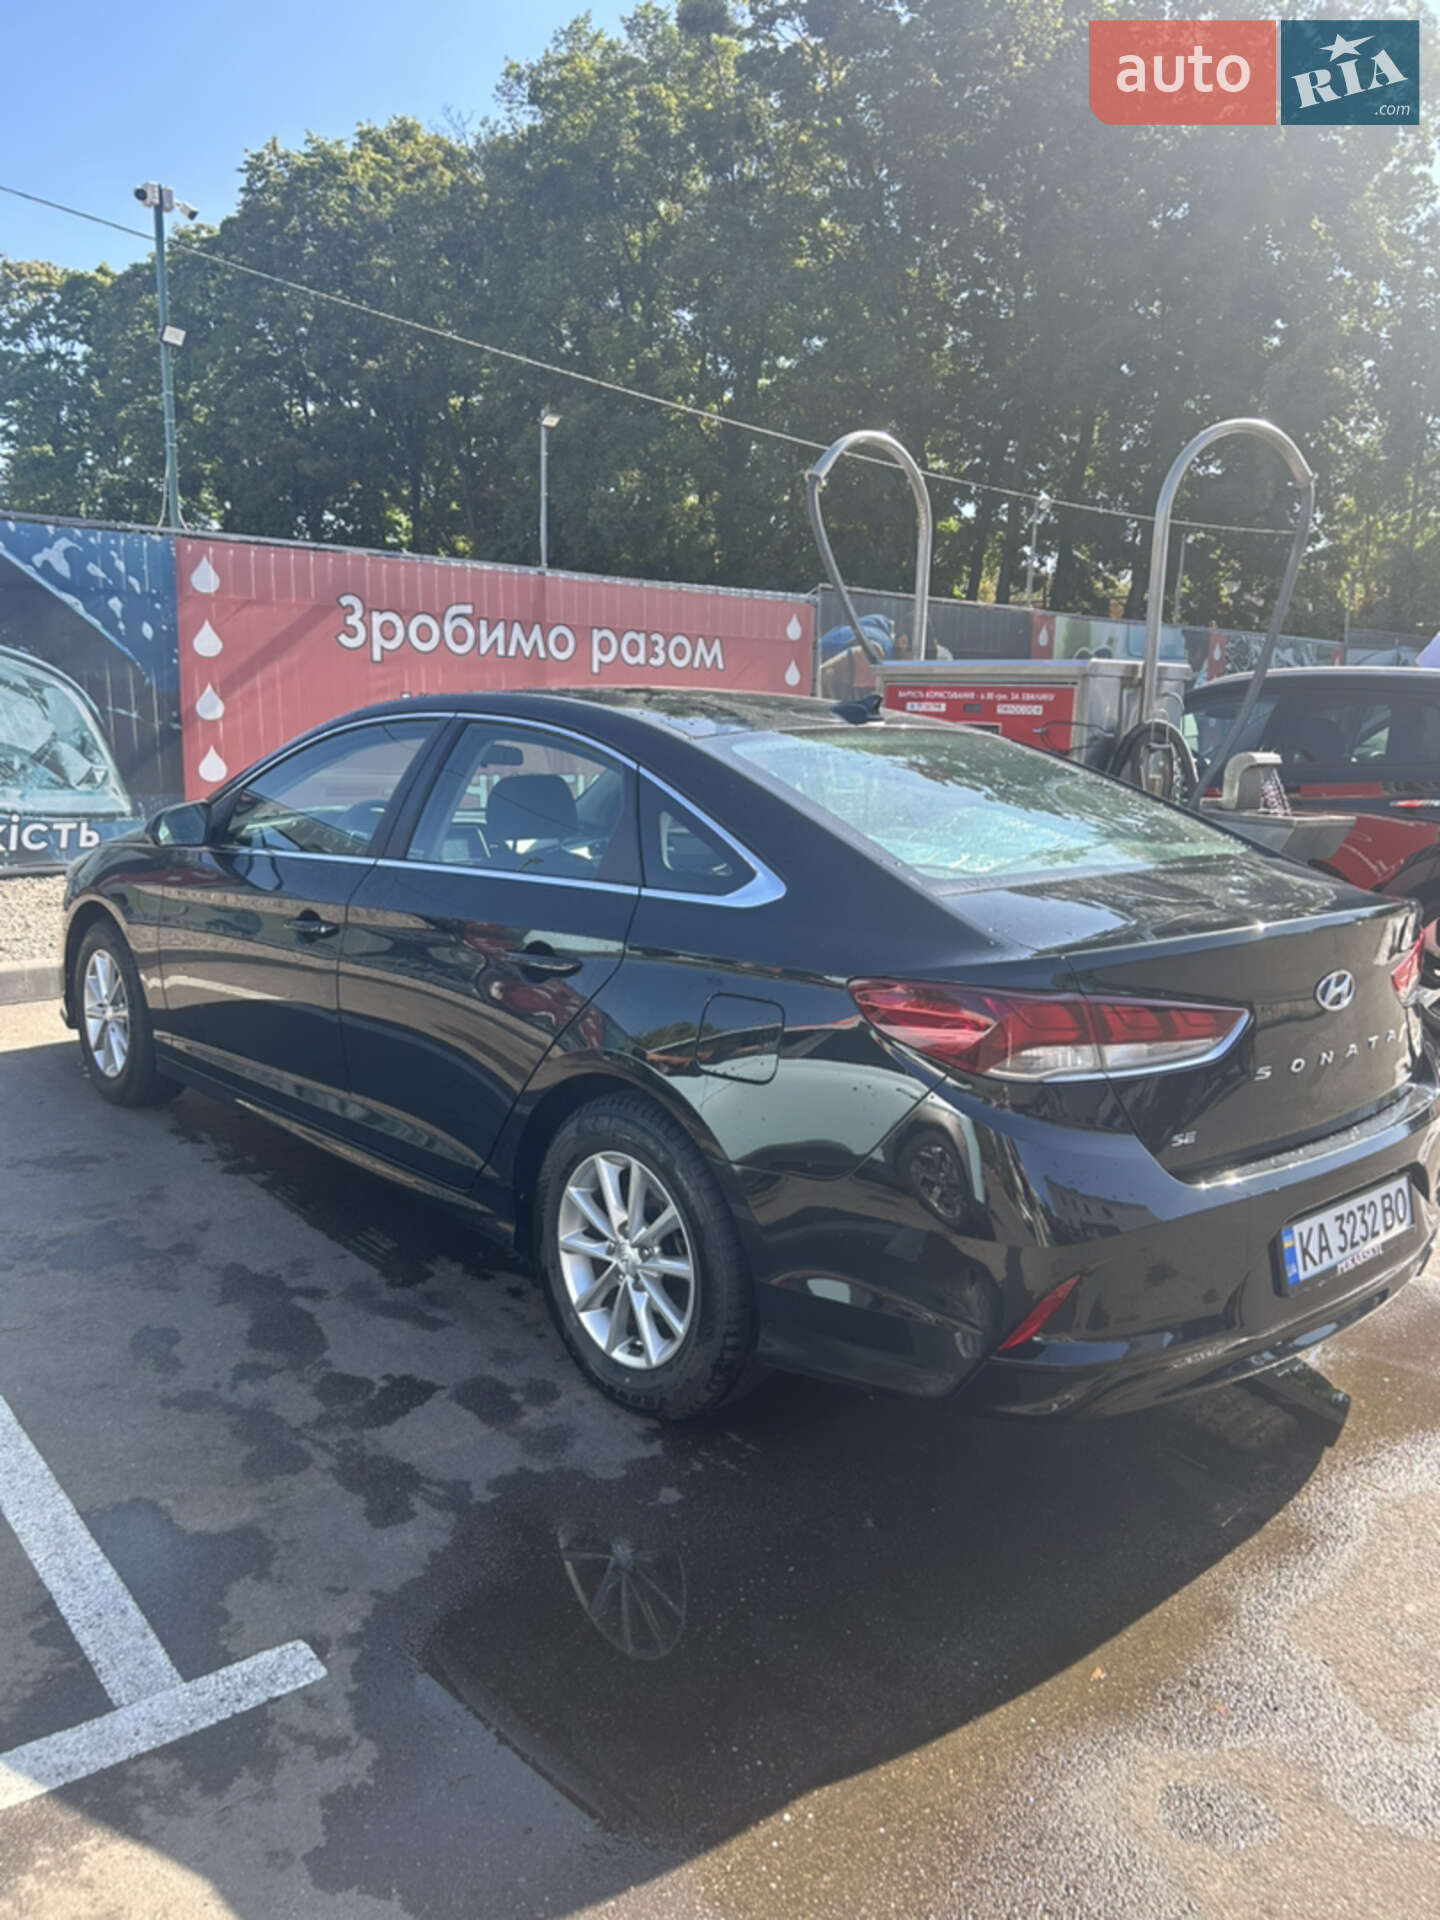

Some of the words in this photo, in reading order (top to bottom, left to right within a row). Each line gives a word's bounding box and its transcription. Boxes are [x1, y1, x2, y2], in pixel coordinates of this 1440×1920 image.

[336, 594, 577, 663] Зробимо
[591, 624, 726, 675] разом
[1254, 1029, 1397, 1081] SONATA
[1171, 1131, 1197, 1147] SE
[1298, 1222, 1333, 1272] KA
[1334, 1199, 1381, 1253] 3232
[1381, 1186, 1408, 1232] BO
